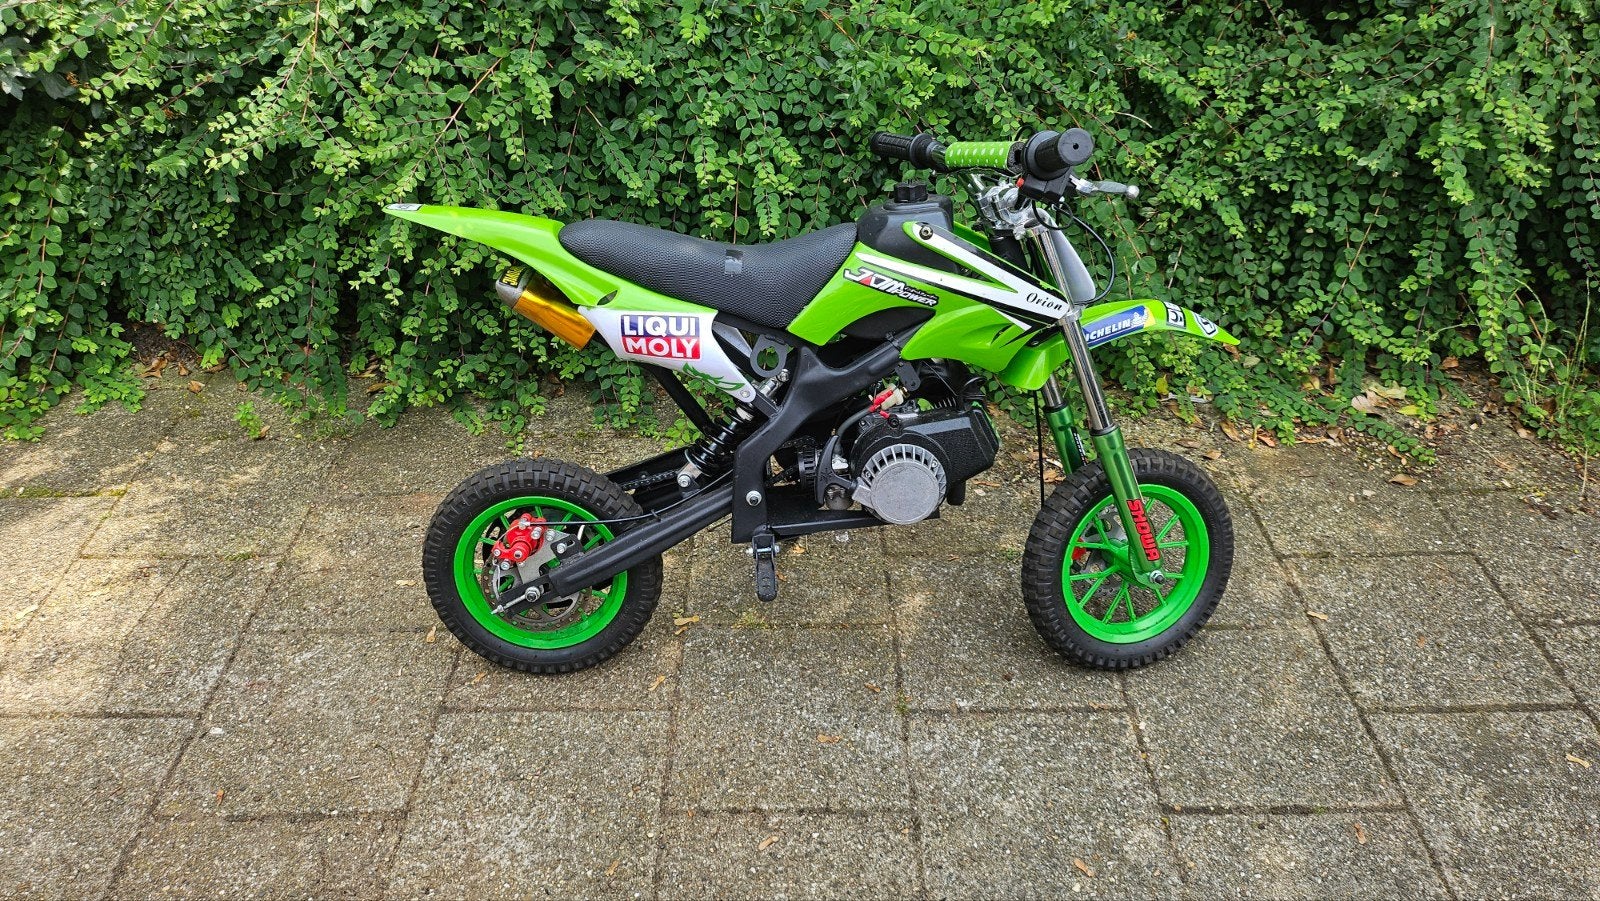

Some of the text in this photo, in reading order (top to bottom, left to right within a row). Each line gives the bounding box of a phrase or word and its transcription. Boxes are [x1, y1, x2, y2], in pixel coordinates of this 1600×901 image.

[893, 288, 937, 306] POWER
[1026, 292, 1063, 310] Orion
[624, 315, 696, 337] LIQUI
[1084, 318, 1131, 342] ICHELIN
[626, 337, 698, 358] MOLY
[1126, 500, 1161, 561] SHOWA
